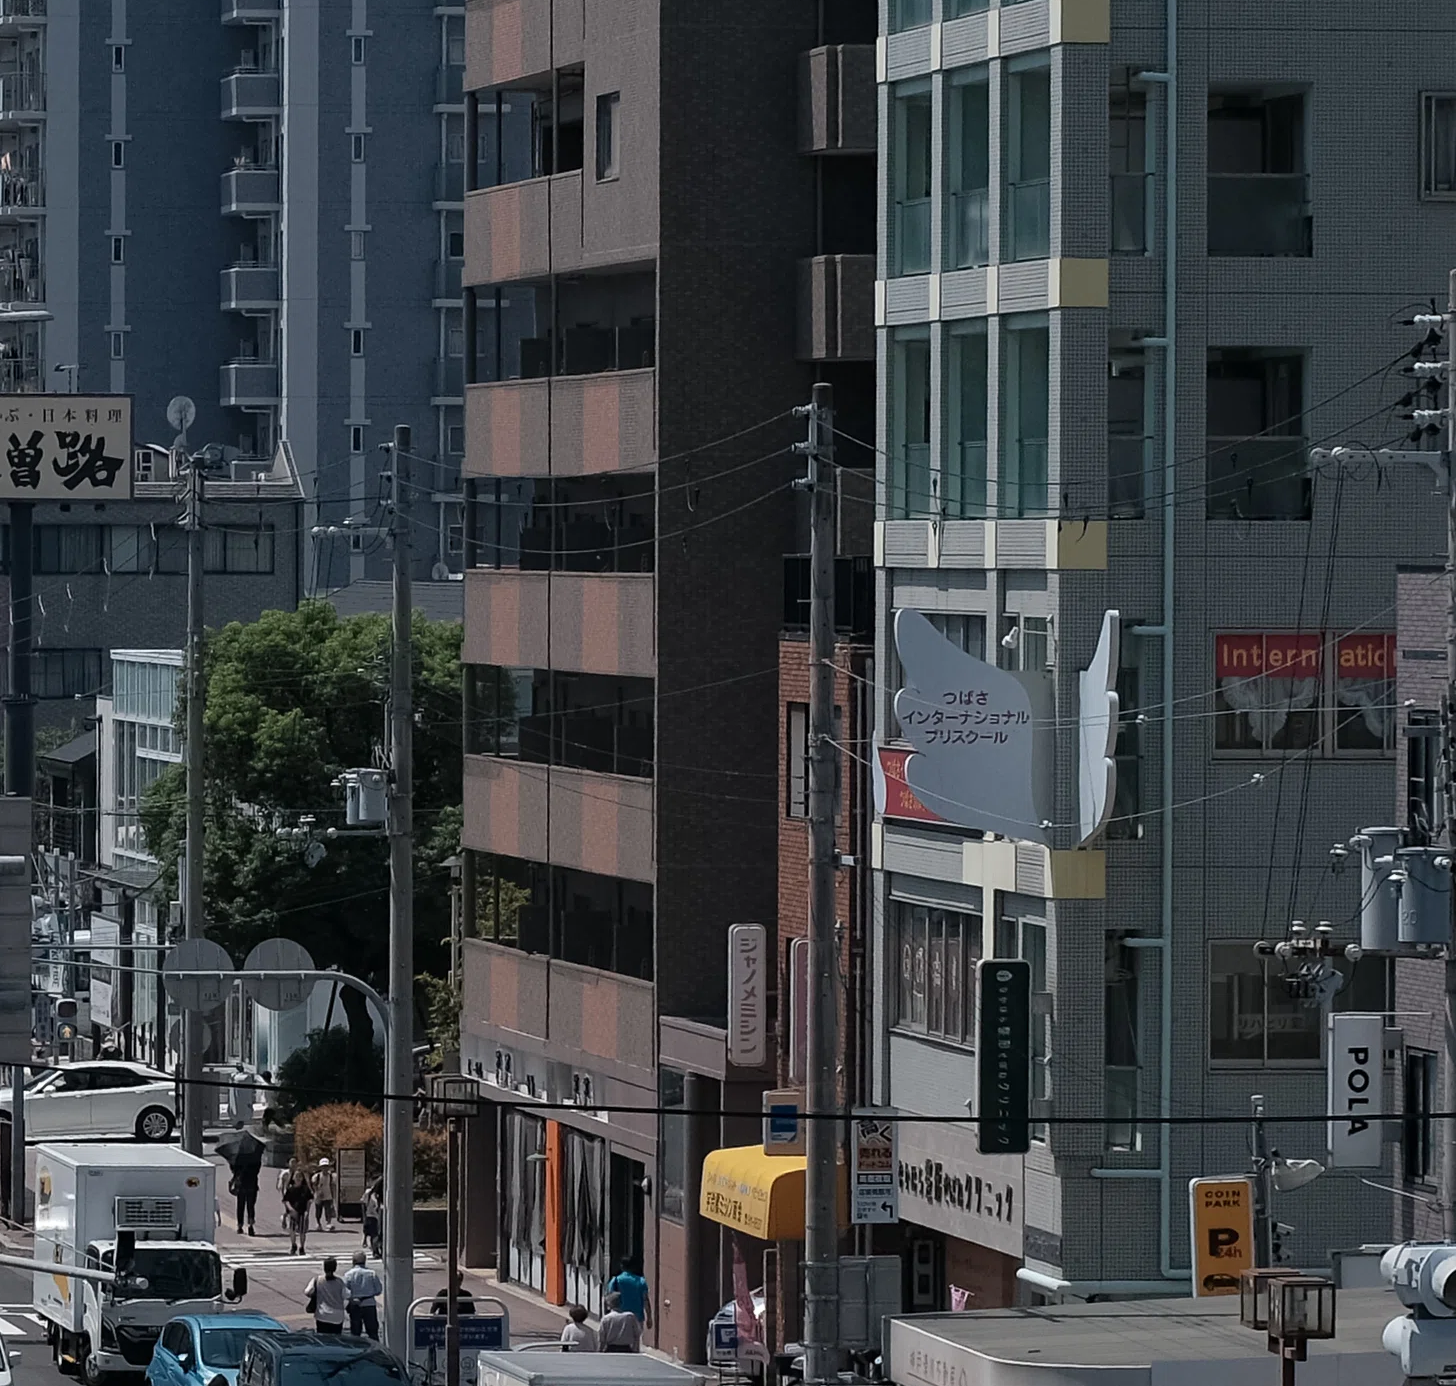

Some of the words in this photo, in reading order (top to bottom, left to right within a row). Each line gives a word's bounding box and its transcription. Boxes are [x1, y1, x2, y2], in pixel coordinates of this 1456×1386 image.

[942, 691, 989, 706] つばさ
[902, 710, 1029, 726] インターナショナル
[924, 729, 1009, 745] プリスクール
[739, 937, 757, 1054] ジャノメミシン
[1347, 1047, 1370, 1136] POLA
[1204, 1190, 1241, 1199] COIN
[1204, 1198, 1241, 1209] PARK
[1208, 1227, 1239, 1258] P
